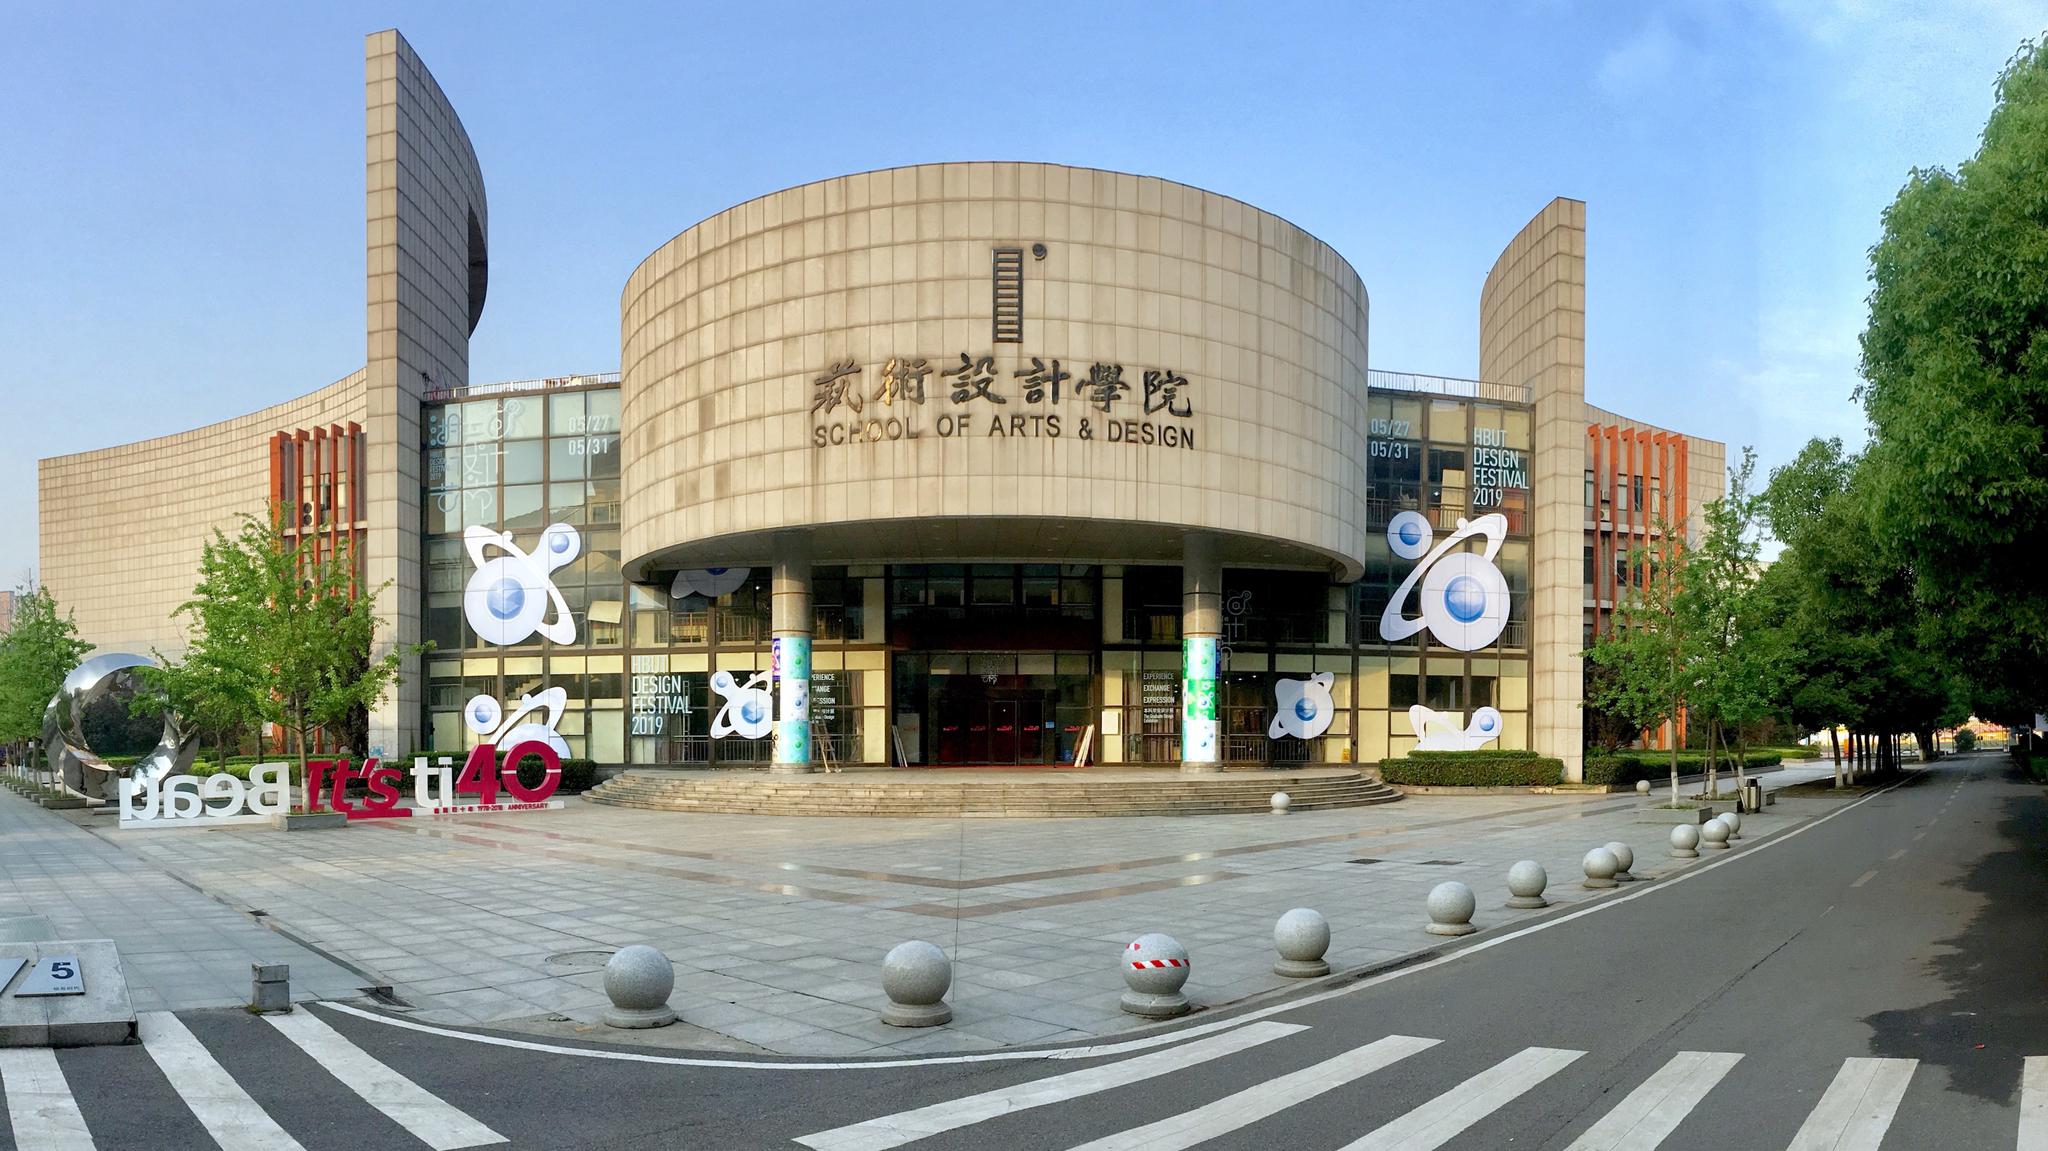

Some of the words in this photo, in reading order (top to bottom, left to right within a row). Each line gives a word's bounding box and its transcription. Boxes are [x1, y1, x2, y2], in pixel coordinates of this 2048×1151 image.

[568, 415, 609, 433] 05/27
[814, 417, 919, 448] SCHOOL
[936, 414, 972, 438] OF
[988, 414, 1061, 438] ARTS
[1079, 418, 1093, 441] &
[1108, 420, 1194, 450] DESIGN
[1371, 418, 1409, 438] 05/27
[568, 438, 609, 456] 05/31
[1473, 428, 1507, 448] HBUT
[1371, 440, 1409, 460] 05/31
[1473, 447, 1519, 469] DESIGN
[1473, 467, 1530, 490] FESTIVAL
[1473, 488, 1503, 507] 2019
[632, 675, 681, 694] DESIGN
[632, 695, 693, 715] FESTIVAL
[1143, 696, 1175, 704] EXPRESSION
[631, 716, 664, 735] 2019
[508, 802, 549, 811] ANNIVERSARY
[51, 962, 75, 979] 5
